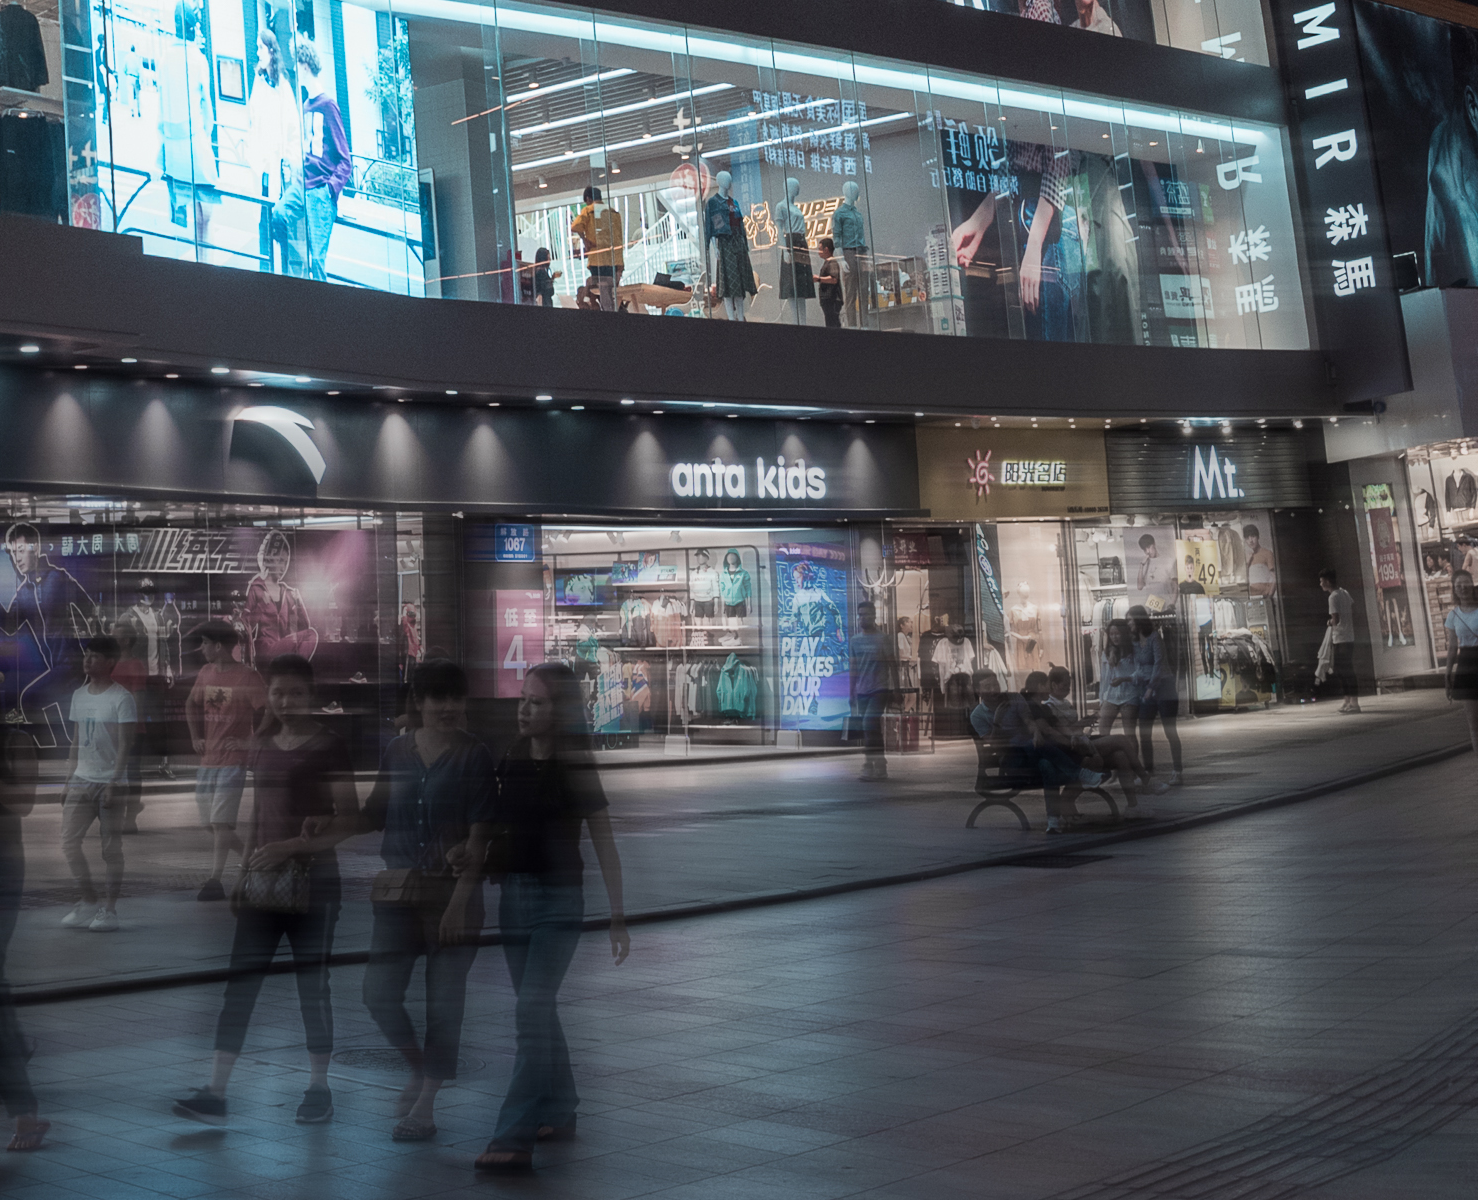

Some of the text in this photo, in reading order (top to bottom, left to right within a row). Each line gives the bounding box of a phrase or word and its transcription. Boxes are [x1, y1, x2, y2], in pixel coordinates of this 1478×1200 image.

[671, 456, 827, 499] anta kids
[1003, 461, 1066, 484] 阳光名店
[1192, 445, 1245, 500] Mt.
[503, 538, 526, 552] 1067
[1198, 563, 1216, 585] 49
[504, 607, 538, 628] 低至
[503, 635, 528, 681] 4
[781, 636, 821, 658] PLAY
[782, 656, 834, 678] MAKES
[782, 677, 822, 697] YOUR
[782, 695, 813, 717] DAY
